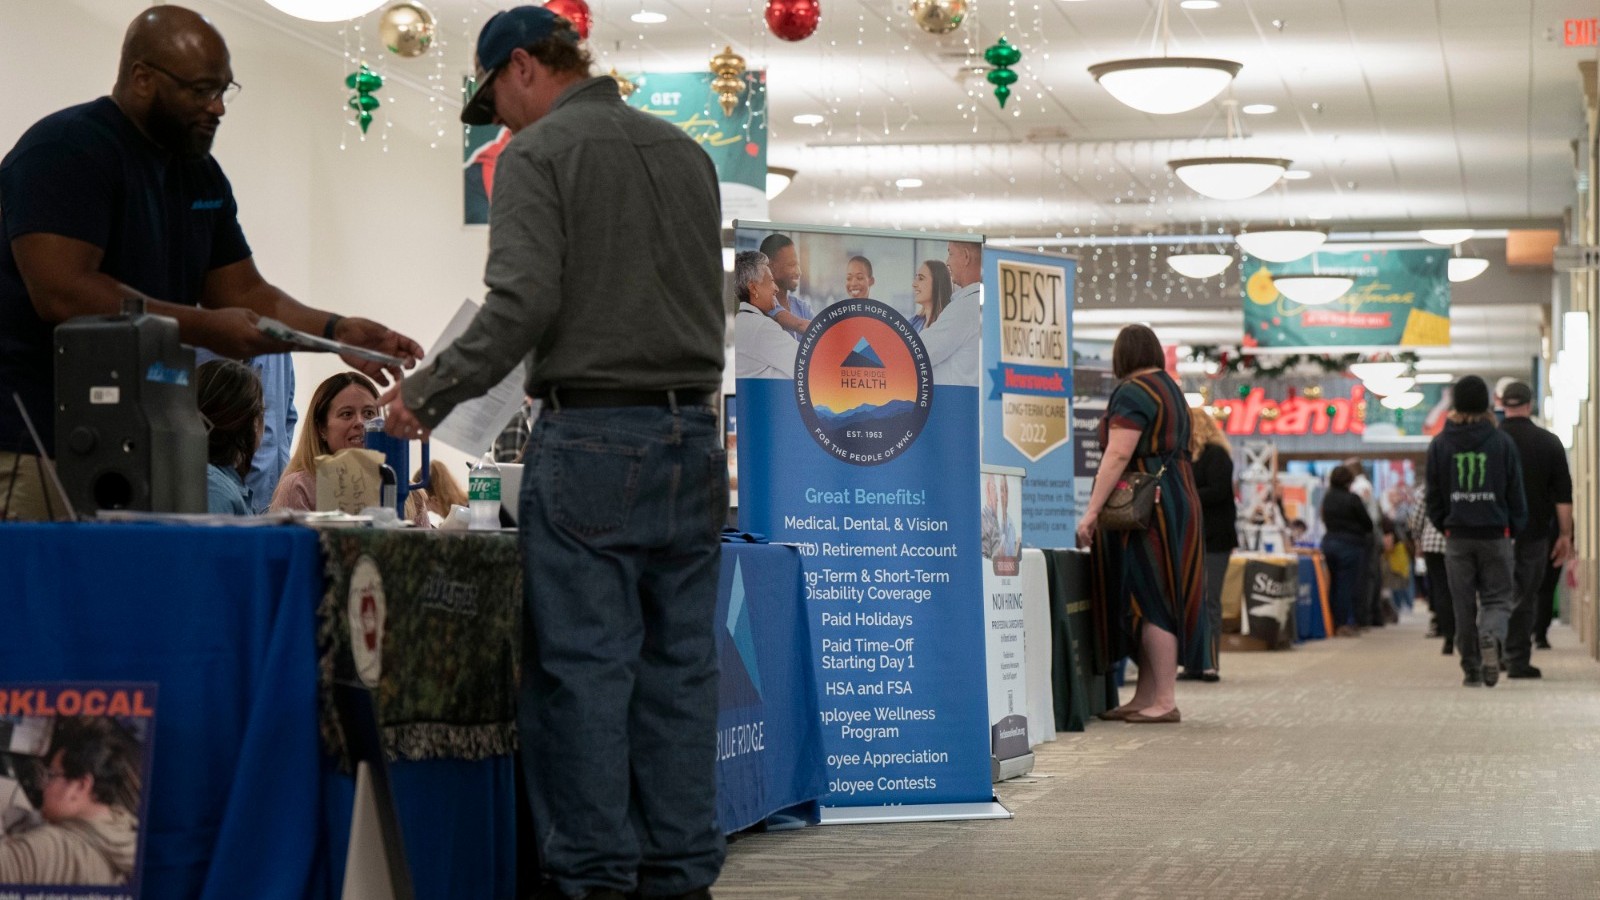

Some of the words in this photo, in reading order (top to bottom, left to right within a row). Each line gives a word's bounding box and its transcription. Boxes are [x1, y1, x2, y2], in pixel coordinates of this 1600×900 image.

[1564, 18, 1600, 47] EXI
[650, 91, 682, 106] GET
[1002, 269, 1062, 327] BEST
[828, 303, 862, 320] INSPIRE
[864, 304, 888, 318] HOPE
[801, 321, 823, 356] HEALTH
[894, 320, 924, 360] ADVANCE
[919, 363, 928, 408] HEALING
[797, 358, 807, 405] IMPROVE
[841, 369, 861, 377] BLUE
[864, 370, 887, 379] RIDGE
[841, 379, 887, 390] HEALTH
[1045, 404, 1066, 419] CARE
[846, 430, 863, 438] EST.
[865, 431, 883, 439] 1963
[1019, 423, 1047, 444] 2022
[815, 427, 830, 446] FOR
[831, 443, 847, 458] THE
[849, 452, 883, 462] PEOPLE
[884, 446, 895, 458] OF
[895, 430, 913, 449] WNC
[469, 478, 491, 492] rite
[805, 487, 850, 504] Great
[855, 488, 926, 505] Benefits!
[784, 515, 840, 532] Medical,
[843, 516, 891, 532] Dental,
[894, 517, 904, 531] &
[906, 517, 948, 532] Vision
[800, 542, 819, 557] (b)
[822, 542, 898, 557] Retirement
[900, 543, 958, 557] Account
[804, 569, 857, 586] ng-Term
[861, 569, 871, 583] &
[874, 569, 950, 583] Short-Term
[805, 586, 864, 604] Disability
[867, 586, 932, 604] Coverage
[821, 612, 851, 626] Paid
[855, 612, 913, 629] Holidays
[822, 638, 851, 652] Paid
[854, 637, 915, 652] Time-Off
[821, 655, 876, 672] Starting
[879, 655, 905, 672] Day
[907, 655, 915, 668] 1
[825, 681, 855, 696] HSA
[857, 680, 884, 695] and
[887, 680, 913, 695] FSA
[820, 707, 871, 726] ployee
[873, 706, 936, 721] Wellness
[737, 721, 765, 756] RIDGE
[841, 725, 899, 742] Program
[827, 753, 861, 769] oyee
[863, 749, 949, 768] Appreciation
[829, 778, 874, 796] ployee
[877, 775, 937, 790] Contests
